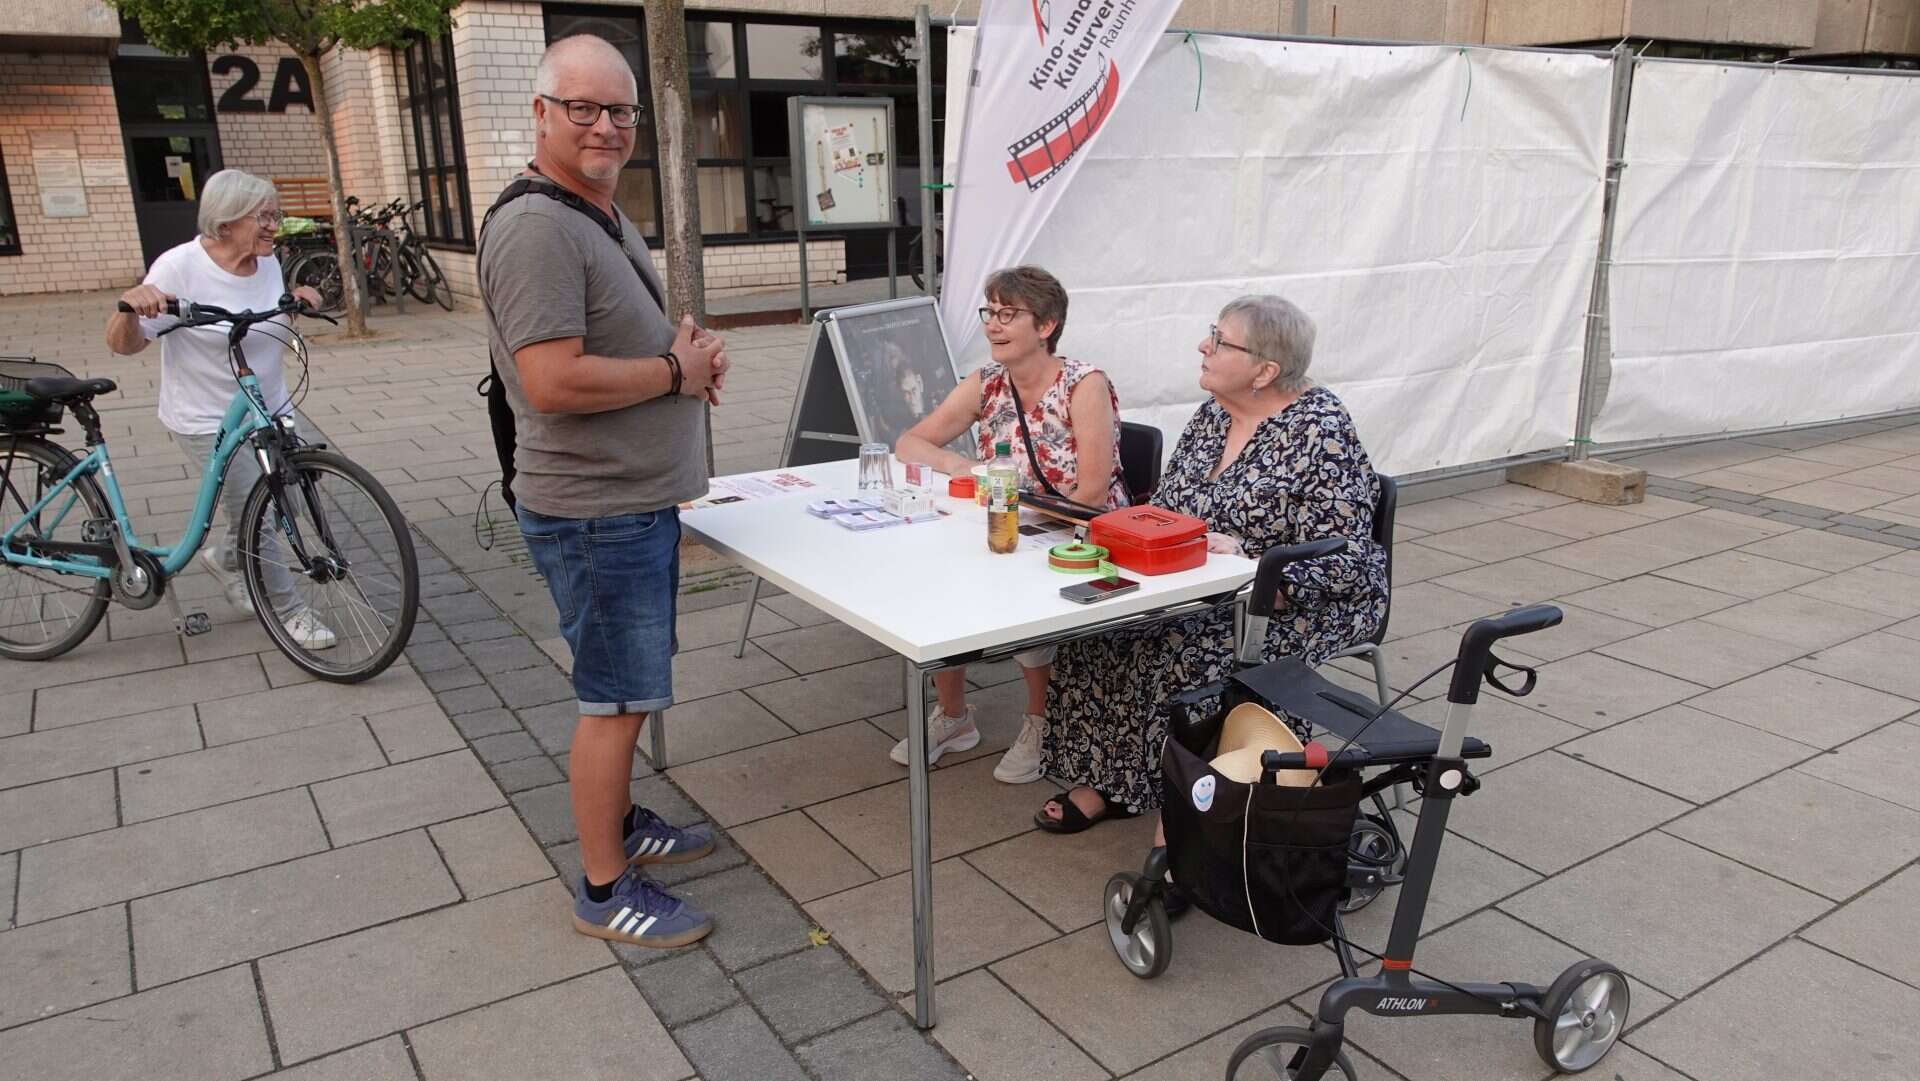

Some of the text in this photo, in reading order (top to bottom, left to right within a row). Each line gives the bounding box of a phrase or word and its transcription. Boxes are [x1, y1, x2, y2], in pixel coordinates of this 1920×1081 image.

[211, 55, 315, 113] 2A
[1028, 39, 1065, 91] Kino-
[1376, 997, 1427, 1011] ATHLON
